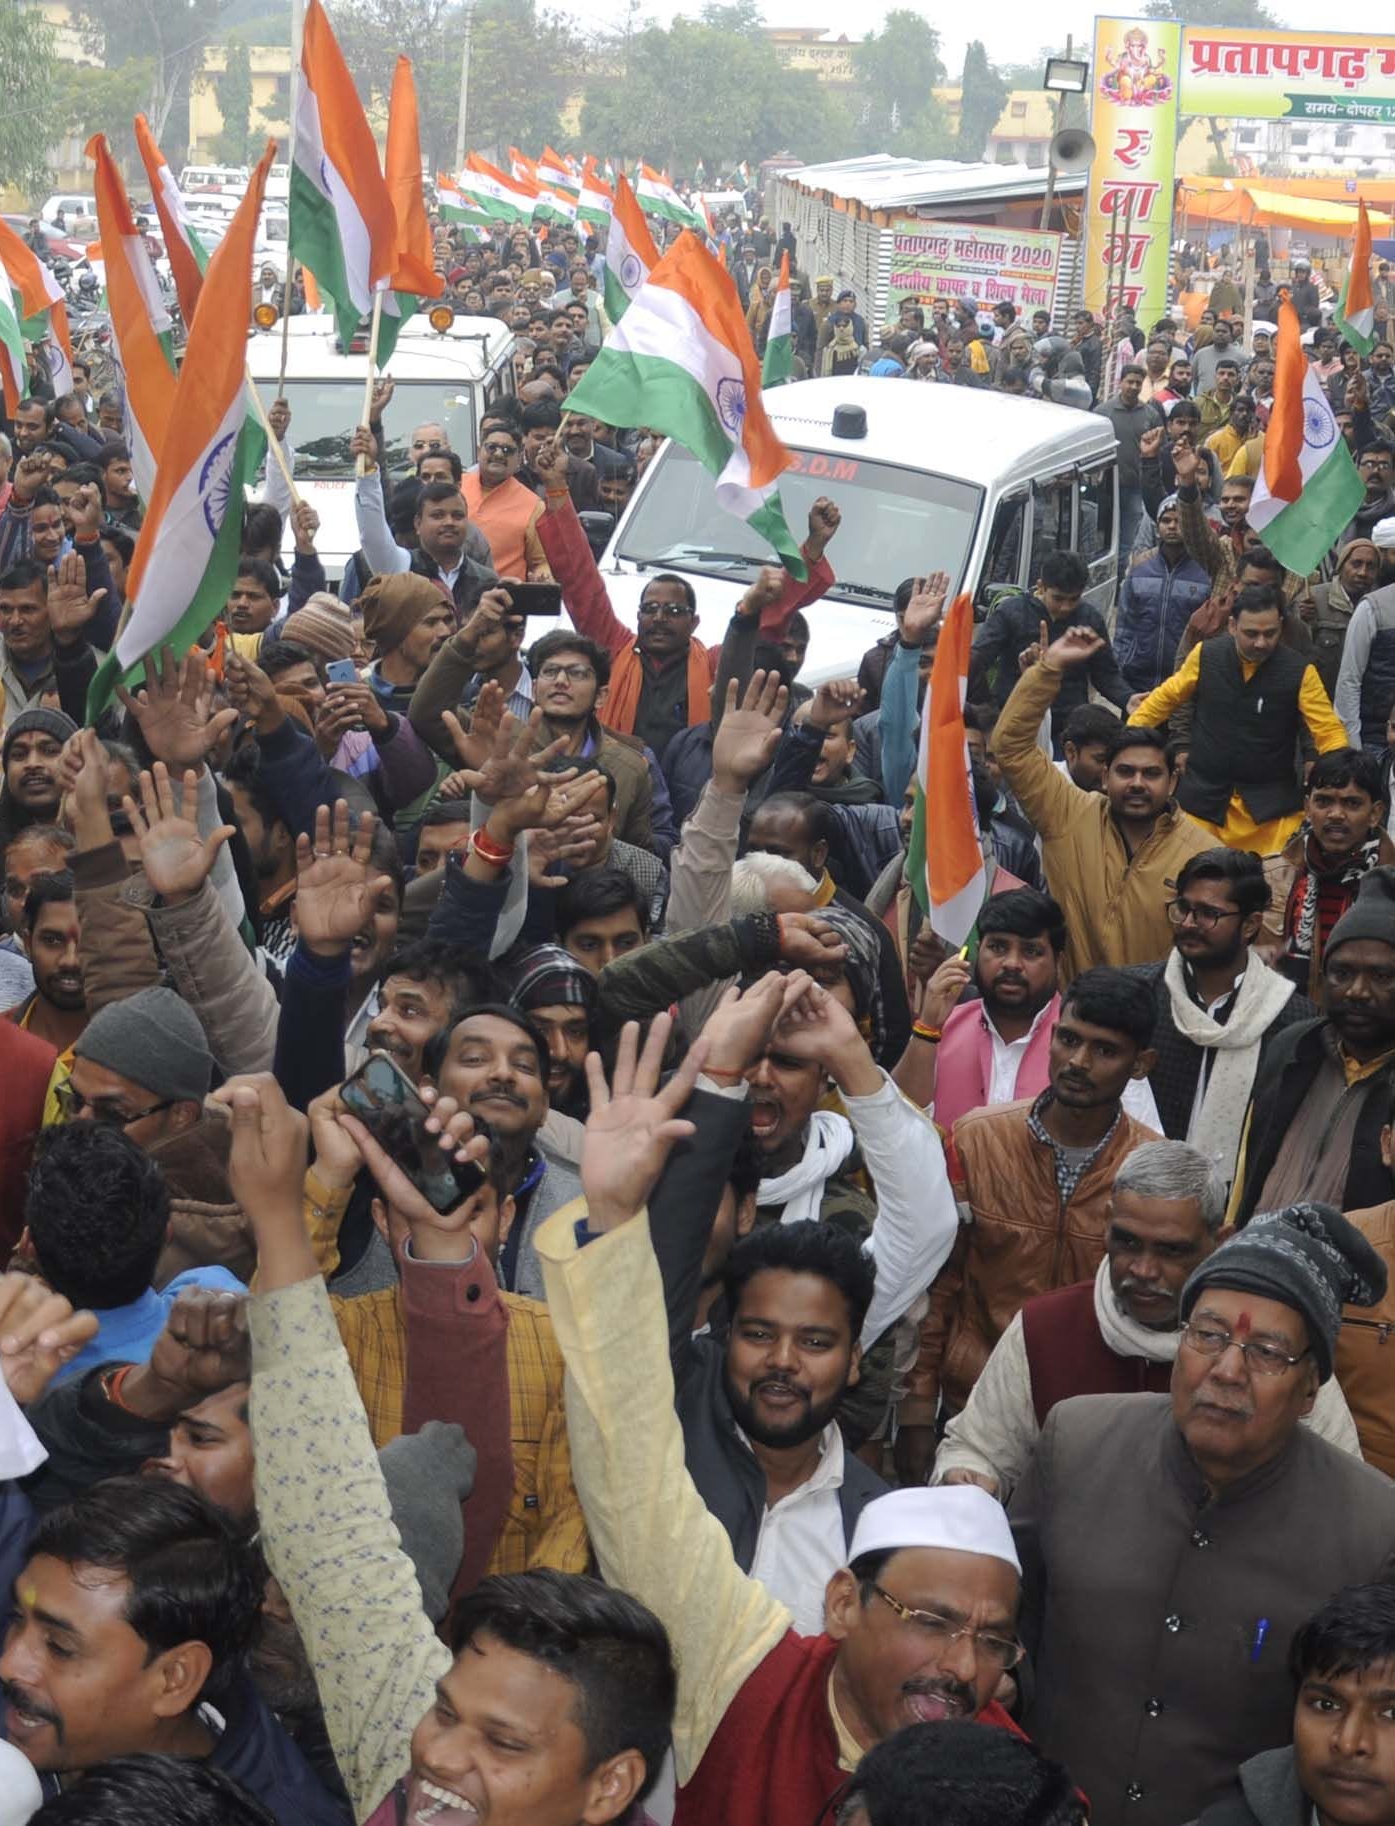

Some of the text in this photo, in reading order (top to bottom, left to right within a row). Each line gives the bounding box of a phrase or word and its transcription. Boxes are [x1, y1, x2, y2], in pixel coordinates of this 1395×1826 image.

[1189, 40, 1370, 88] प्रतापगढ़
[954, 234, 1008, 262] महोत्सव
[1011, 244, 1053, 268] 2020
[985, 277, 1017, 304] शिल्प
[1021, 282, 1048, 306] मेला
[313, 480, 347, 489] POLICE
